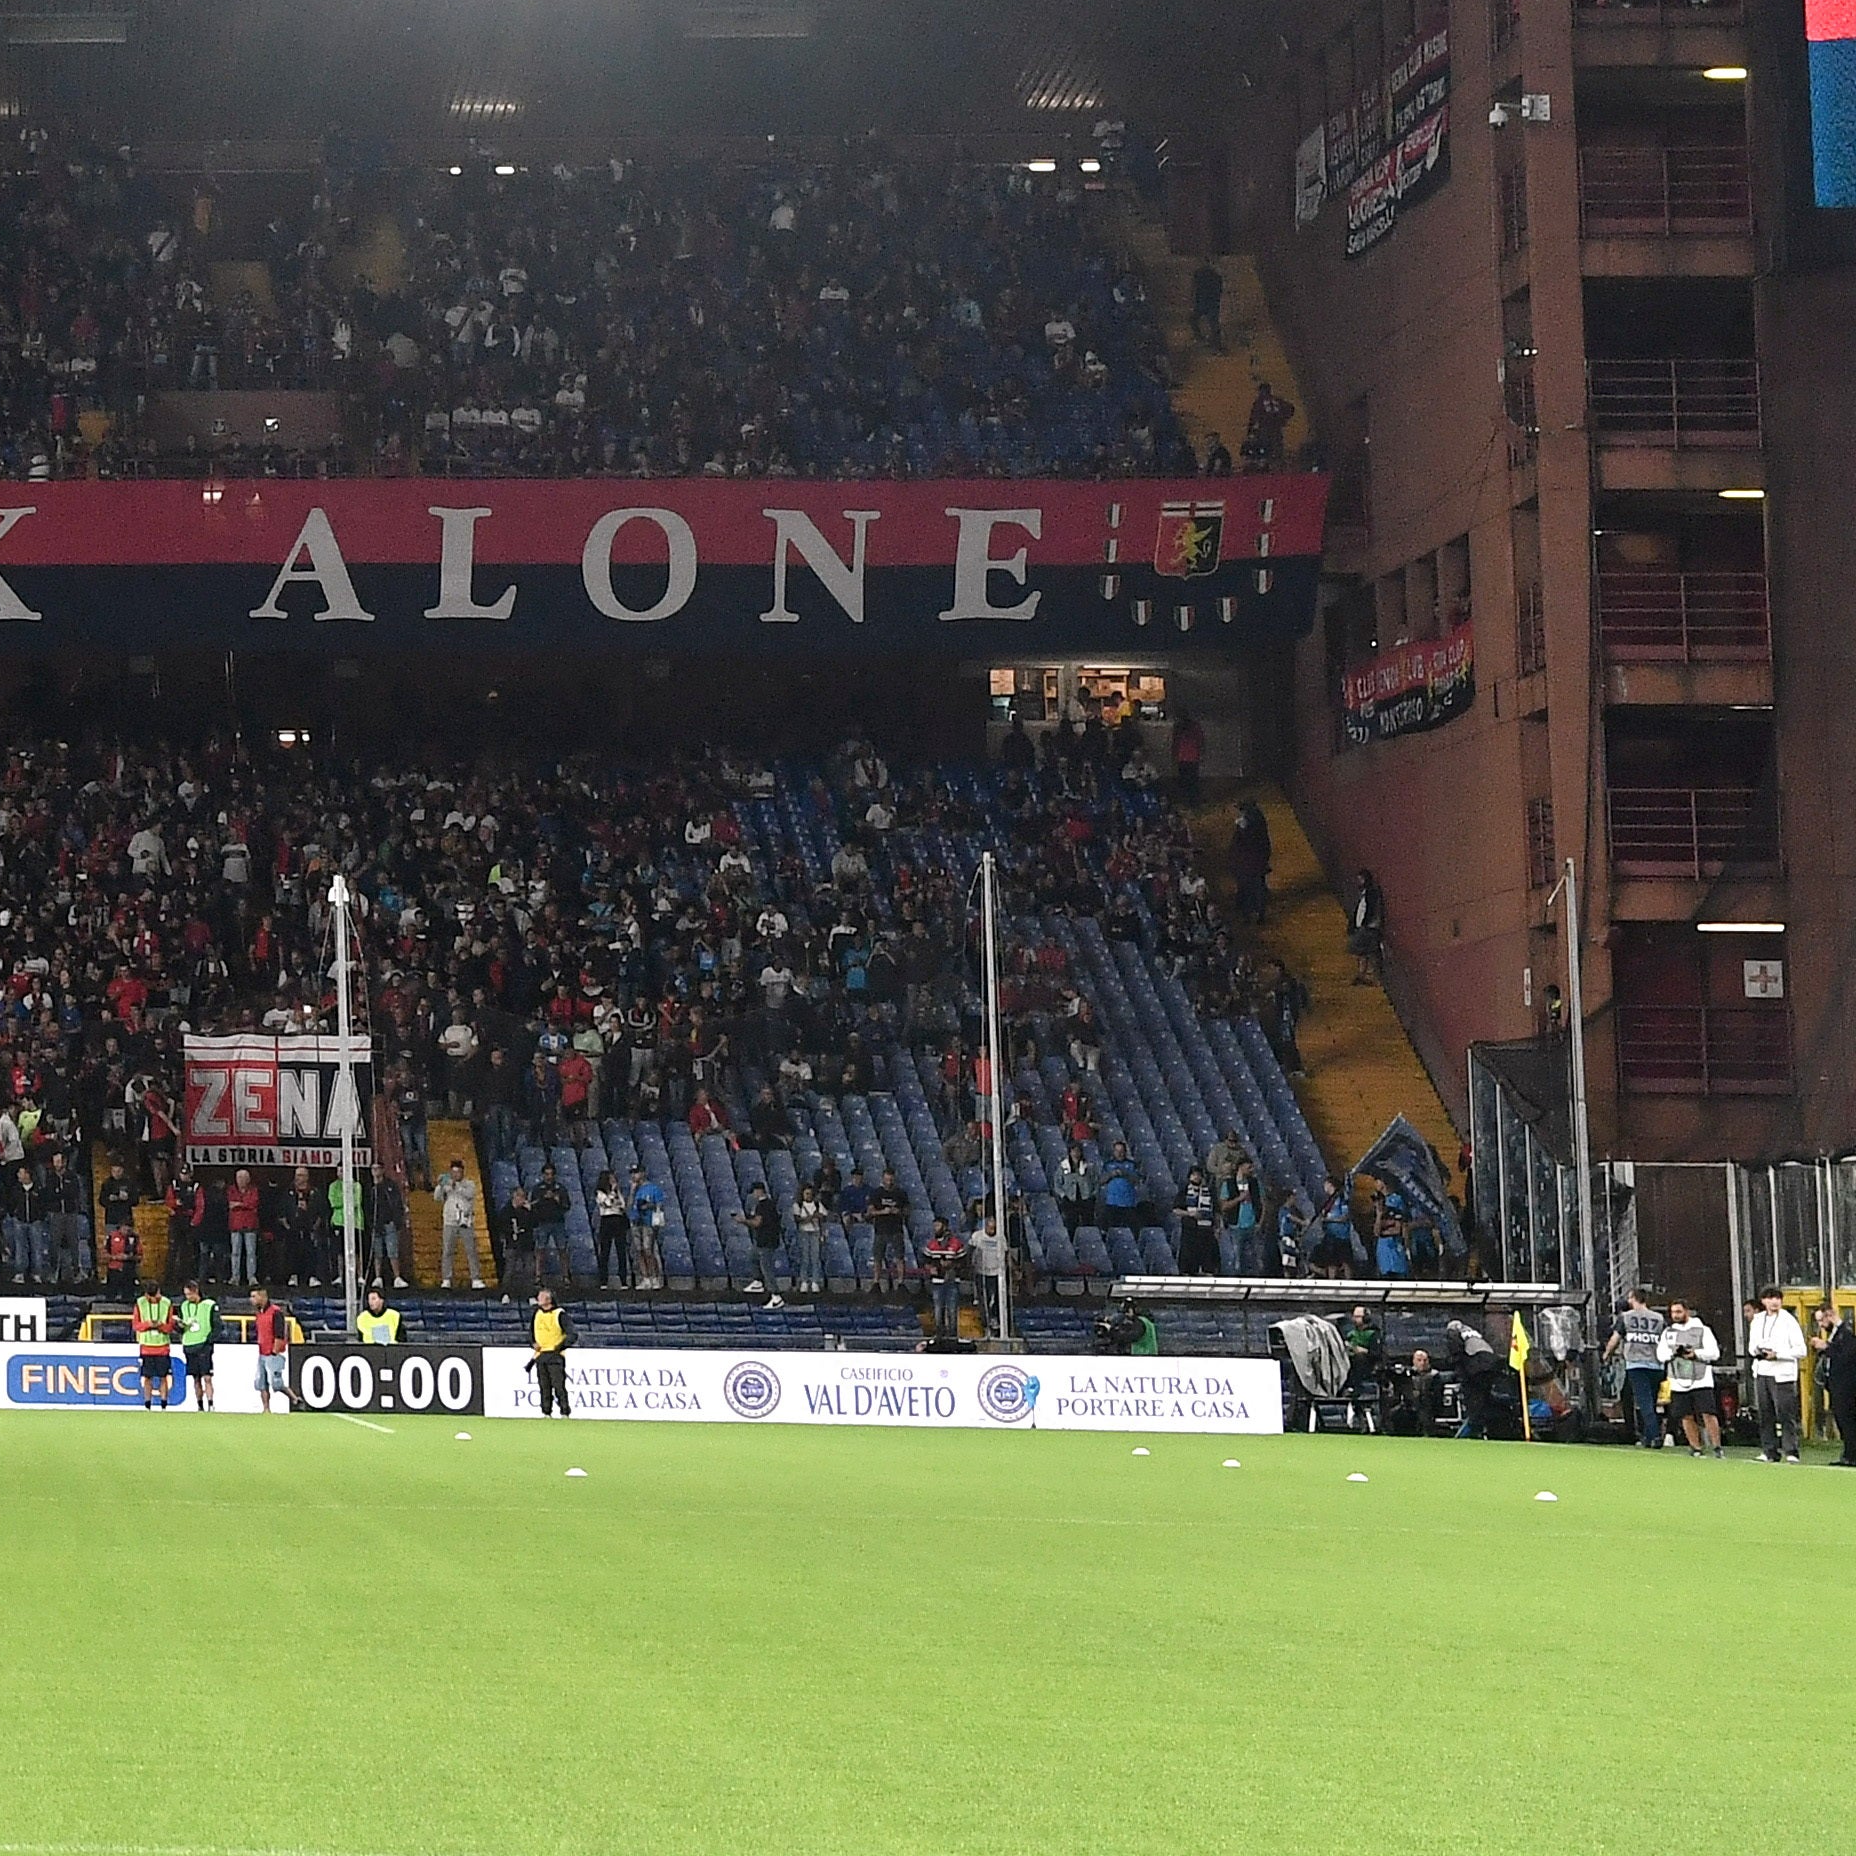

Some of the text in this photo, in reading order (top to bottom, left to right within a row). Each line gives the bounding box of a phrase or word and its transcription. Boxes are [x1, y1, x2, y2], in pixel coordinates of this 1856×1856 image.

[248, 506, 1045, 624] ALONE
[189, 1068, 367, 1139] ZENA
[191, 1149, 211, 1163] LA
[218, 1148, 275, 1164] STORIA
[282, 1150, 332, 1165] SIAMO
[1630, 1316, 1660, 1330] 337
[20, 1364, 174, 1396] FINEC
[300, 1353, 473, 1410] 00:00
[565, 1368, 651, 1386] NATURA
[659, 1369, 687, 1387] DA
[840, 1367, 913, 1381] CASEIFICIO
[1071, 1376, 1235, 1396] LA NATURA DA
[513, 1389, 702, 1410] POARE A CASA
[804, 1384, 848, 1416] VAL
[855, 1385, 956, 1418] D'AVETO
[1056, 1397, 1251, 1419] PORTARE A CASA
